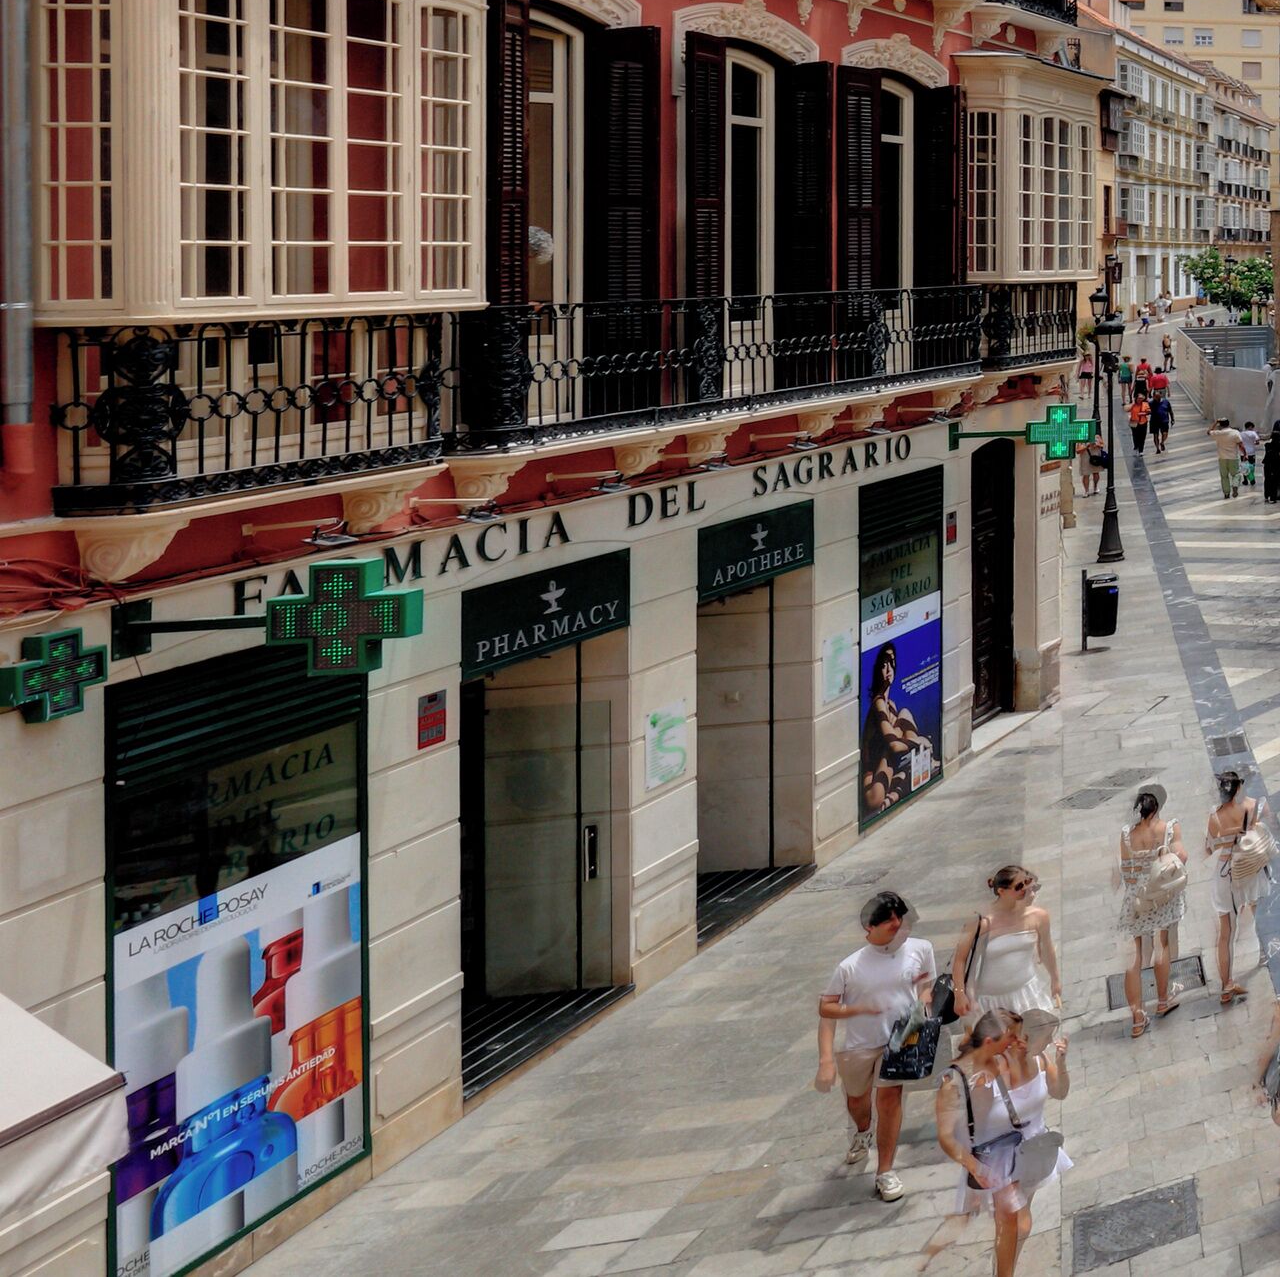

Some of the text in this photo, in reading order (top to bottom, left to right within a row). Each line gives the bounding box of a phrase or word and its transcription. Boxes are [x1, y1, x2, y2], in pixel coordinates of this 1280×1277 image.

[233, 433, 912, 616] FAMACIA DEL SAGRARIO
[712, 542, 805, 588] APOTHEKE
[871, 536, 931, 567] FARMACIA
[890, 562, 912, 584] DEL
[870, 576, 931, 613] SAGRARIO
[475, 599, 620, 663] PHARMACY
[206, 742, 335, 808] RMACIA
[128, 883, 269, 958] LA ROCHE POSAY
[150, 1129, 193, 1160] MARCA
[223, 1101, 239, 1118] EN
[239, 1077, 285, 1108] SÉRUMS
[285, 1047, 336, 1082] ANTIEDAD
[304, 1135, 362, 1178] ROCHE-POSA
[117, 1249, 151, 1277] OCHE
